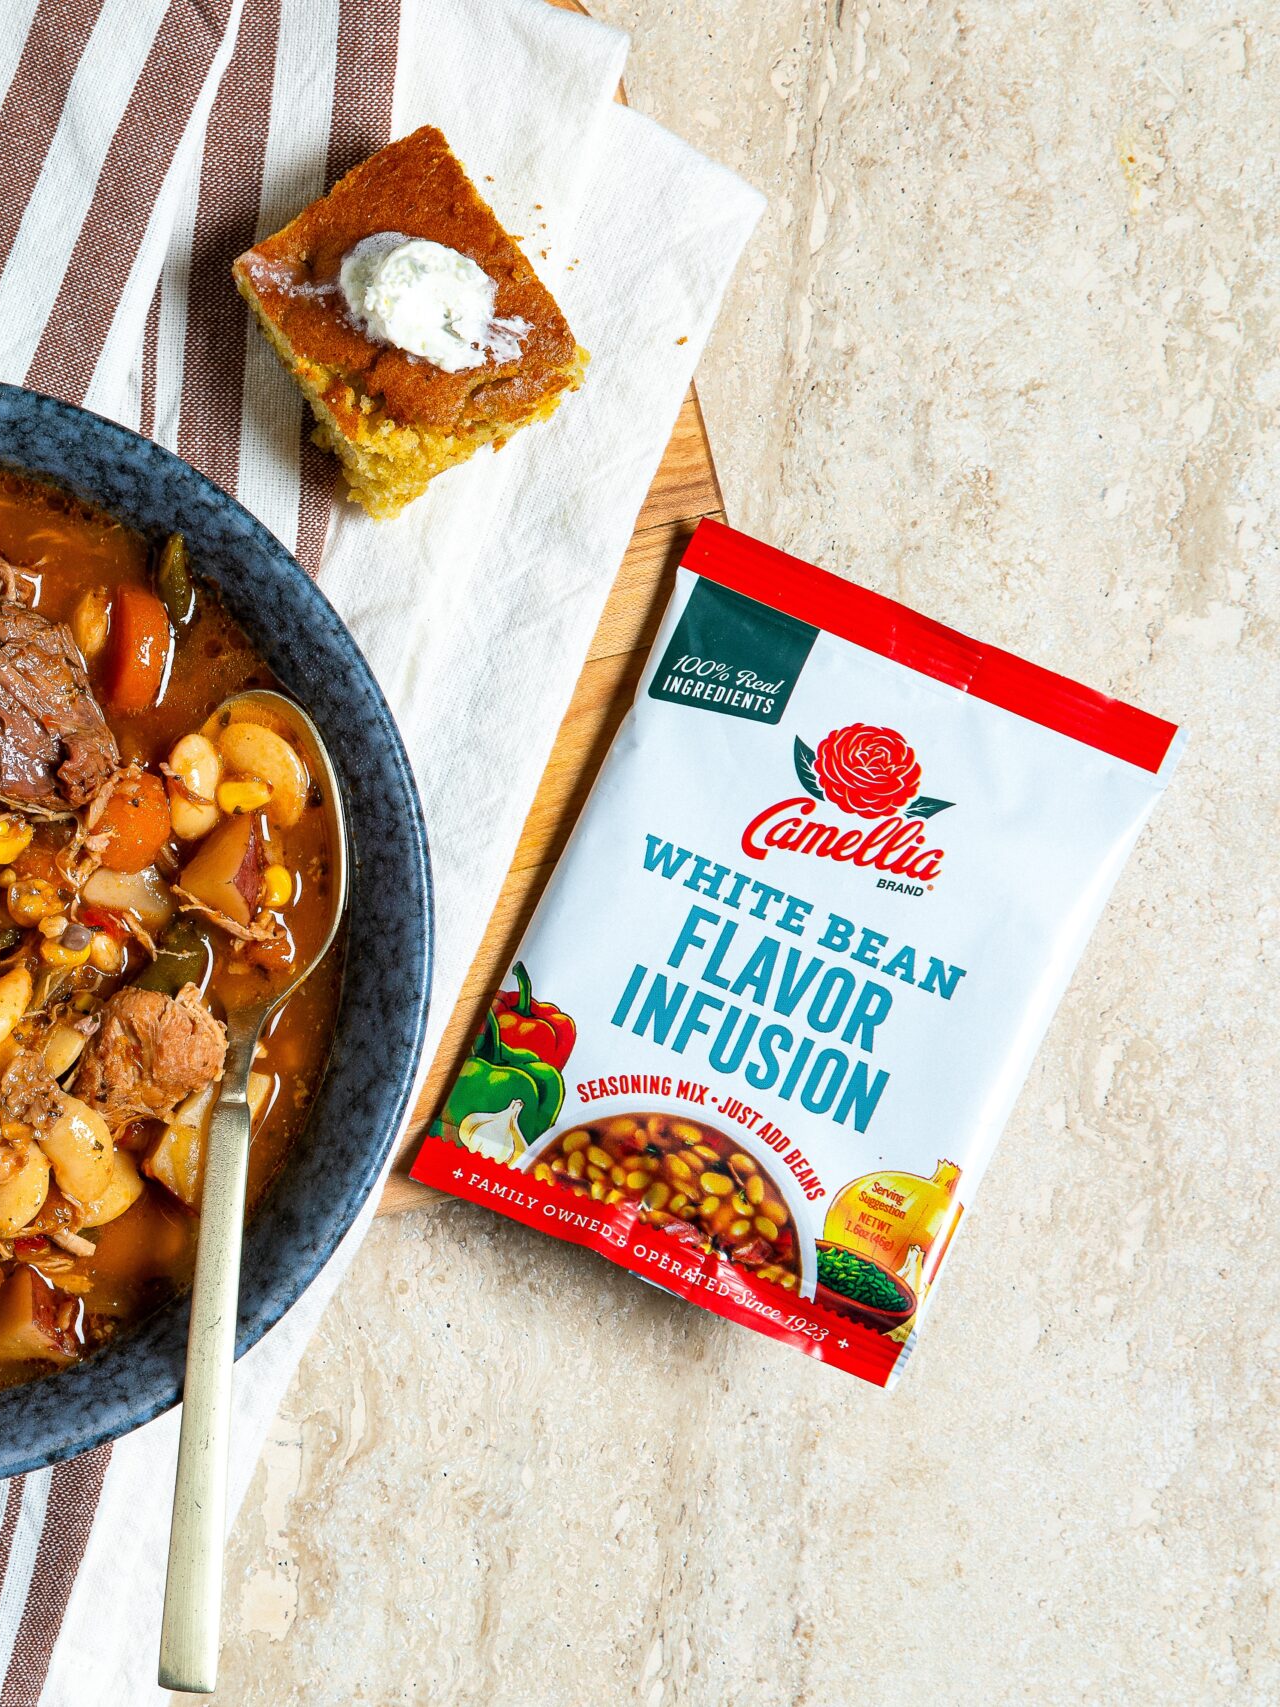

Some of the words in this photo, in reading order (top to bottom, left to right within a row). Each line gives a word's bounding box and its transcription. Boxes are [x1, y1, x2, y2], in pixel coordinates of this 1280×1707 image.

[662, 675, 774, 714] INGREDIENTS
[672, 655, 733, 681] 100%
[736, 669, 785, 695] Real
[741, 797, 944, 881] Camellia
[644, 833, 814, 936] WHITE
[817, 912, 967, 1000] BEAN
[876, 878, 924, 897] BRAND
[667, 904, 893, 1053] FLAVOR
[610, 963, 890, 1134] INFUSION
[577, 1074, 672, 1103] SEASONING
[676, 1079, 710, 1105] MIX
[717, 1096, 764, 1129] JUST
[756, 1121, 792, 1153] ADD
[782, 1148, 827, 1201] BEANS
[859, 1191, 906, 1220] Suggestion
[872, 1181, 906, 1206] Serving
[468, 1173, 539, 1210] FAMILY
[543, 1204, 613, 1238] OWNED
[616, 1235, 627, 1247] &
[633, 1244, 731, 1297] OPERATED
[734, 1290, 782, 1319] Since
[785, 1314, 830, 1342] 1923
